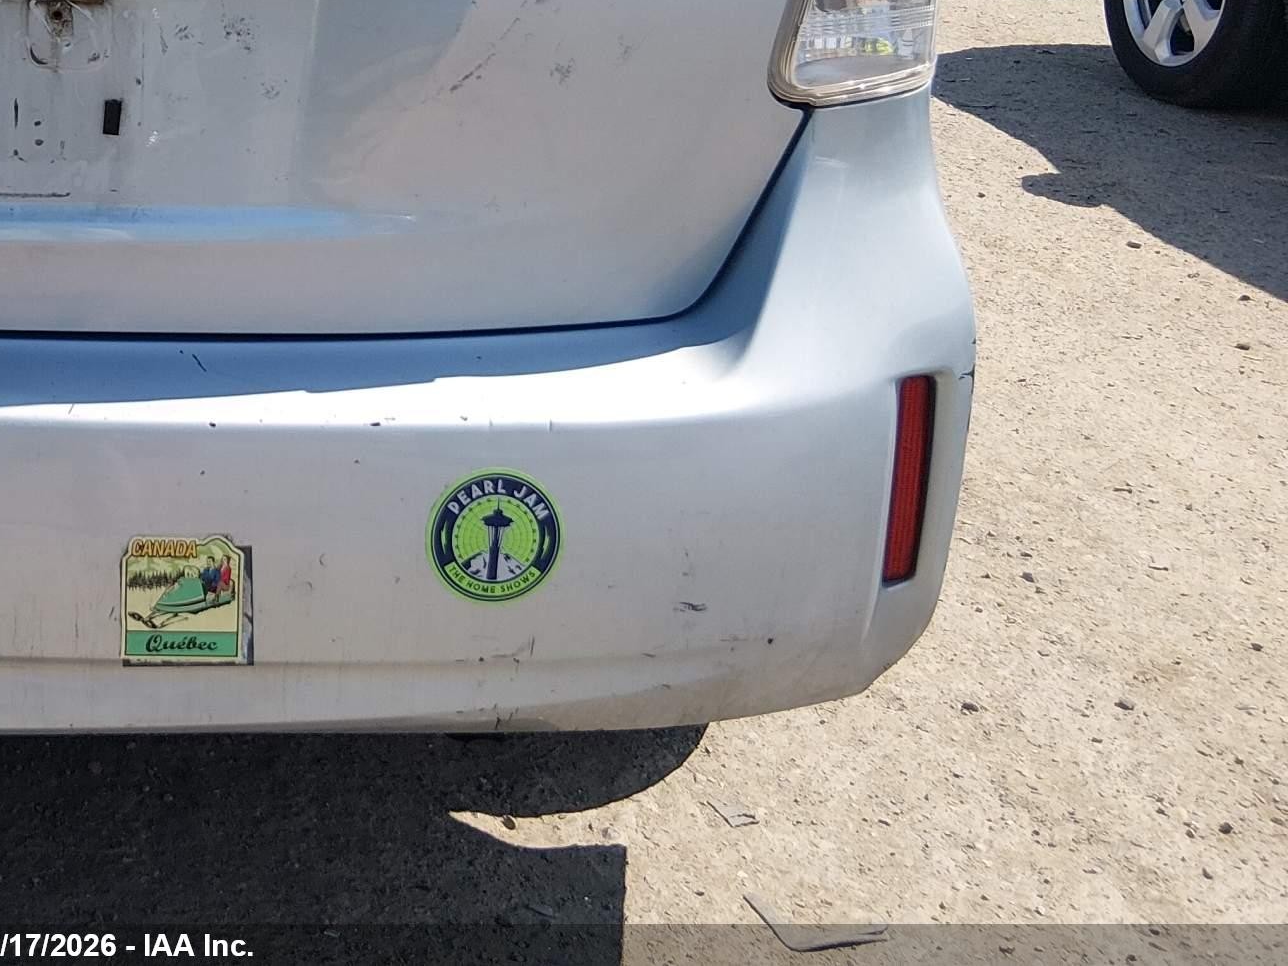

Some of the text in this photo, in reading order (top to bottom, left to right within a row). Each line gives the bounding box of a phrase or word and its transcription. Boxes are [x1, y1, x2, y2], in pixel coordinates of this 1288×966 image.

[447, 479, 550, 521] PEARL JAM
[132, 539, 198, 558] CANADA
[449, 566, 536, 594] THE HOME SHOWS
[145, 634, 219, 653] Québec
